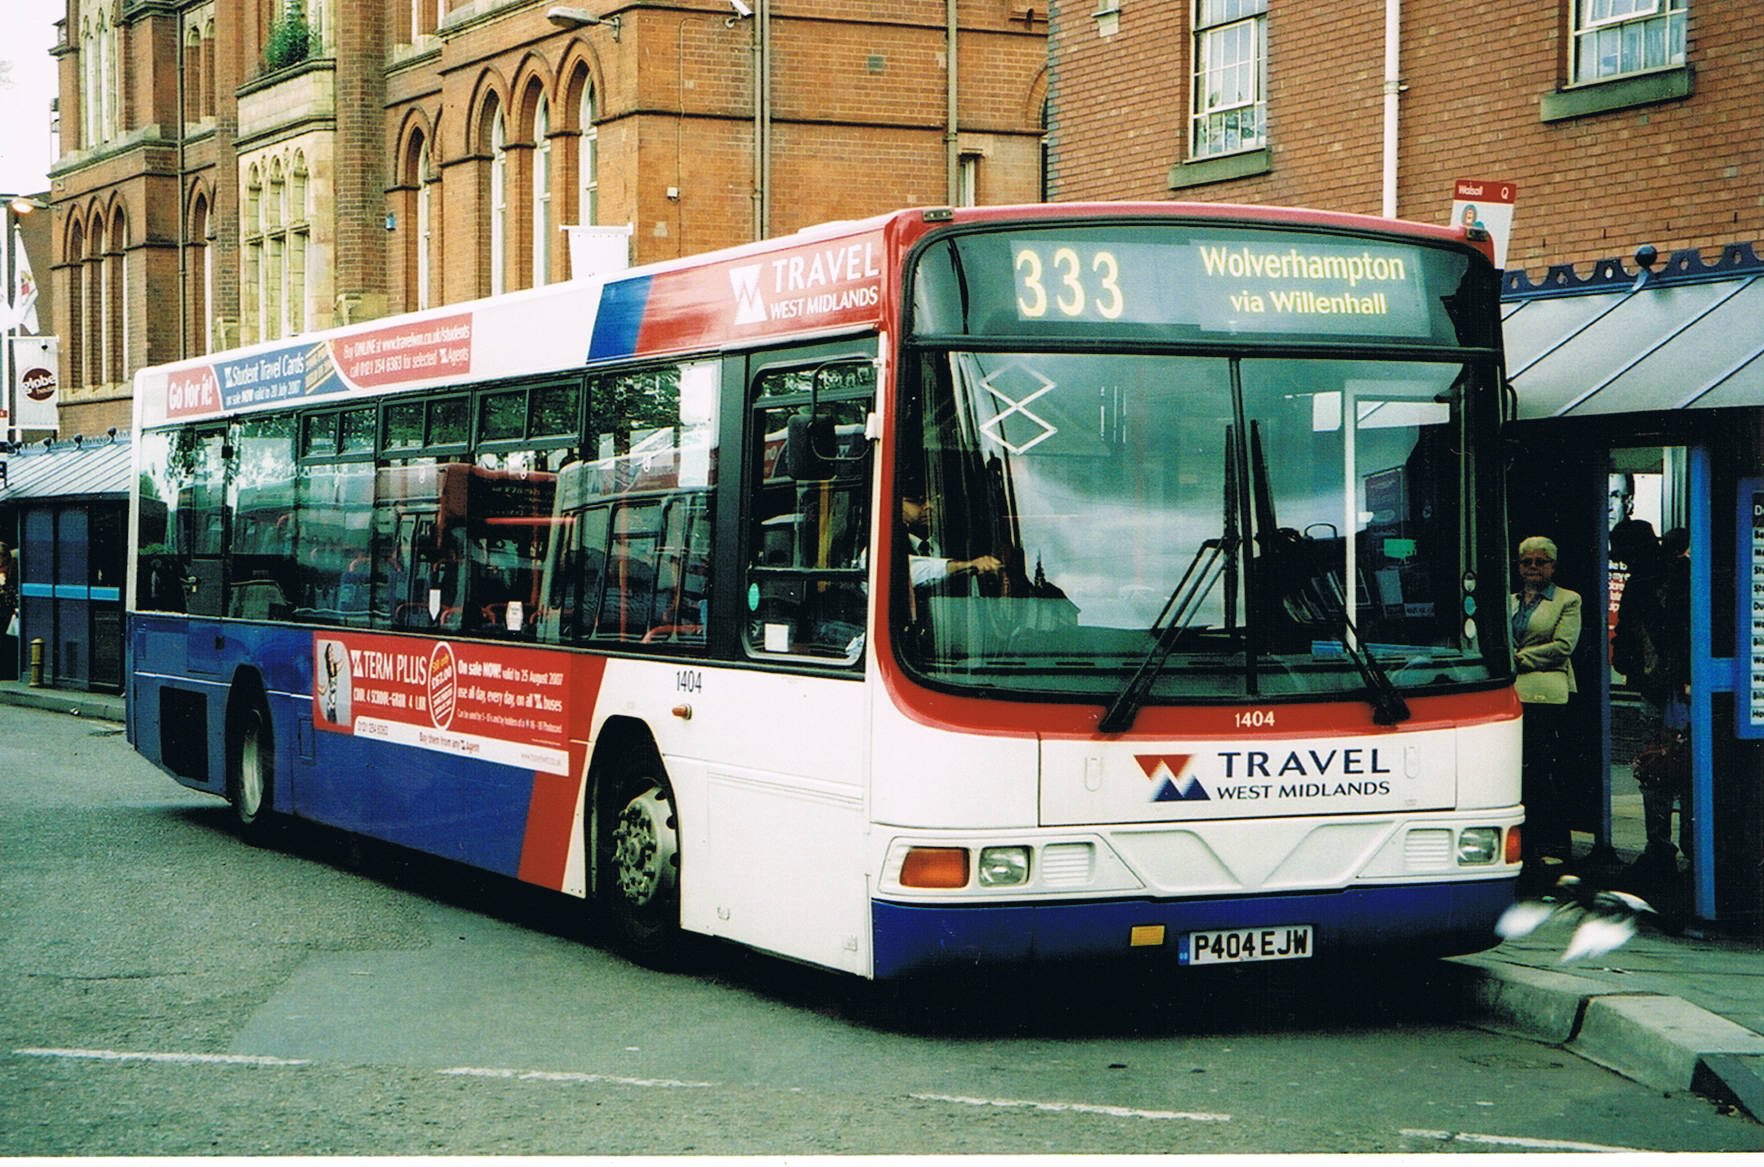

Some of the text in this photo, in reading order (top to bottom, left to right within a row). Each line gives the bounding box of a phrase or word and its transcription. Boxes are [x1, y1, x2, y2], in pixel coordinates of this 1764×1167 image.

[1501, 186, 1509, 199] Q
[772, 242, 880, 294] TRAVEL
[1200, 245, 1406, 287] Wolverhampton
[770, 285, 879, 321] WEST MIDLANDS
[1230, 290, 1388, 316] via Willenhall
[232, 362, 259, 387] Student
[259, 355, 281, 381] Travel
[282, 351, 305, 377] Cards
[169, 382, 184, 410] Go
[184, 379, 201, 408] for
[363, 650, 393, 681] TERM
[396, 653, 427, 686] PLUS
[457, 659, 468, 675] On
[468, 661, 482, 677] sale
[676, 669, 703, 694] 1404
[1234, 710, 1276, 728] 1404
[1217, 748, 1391, 778] TRAVEL
[1216, 780, 1390, 800] WEST MIDLANDS
[1194, 928, 1308, 961] P404 EJW
